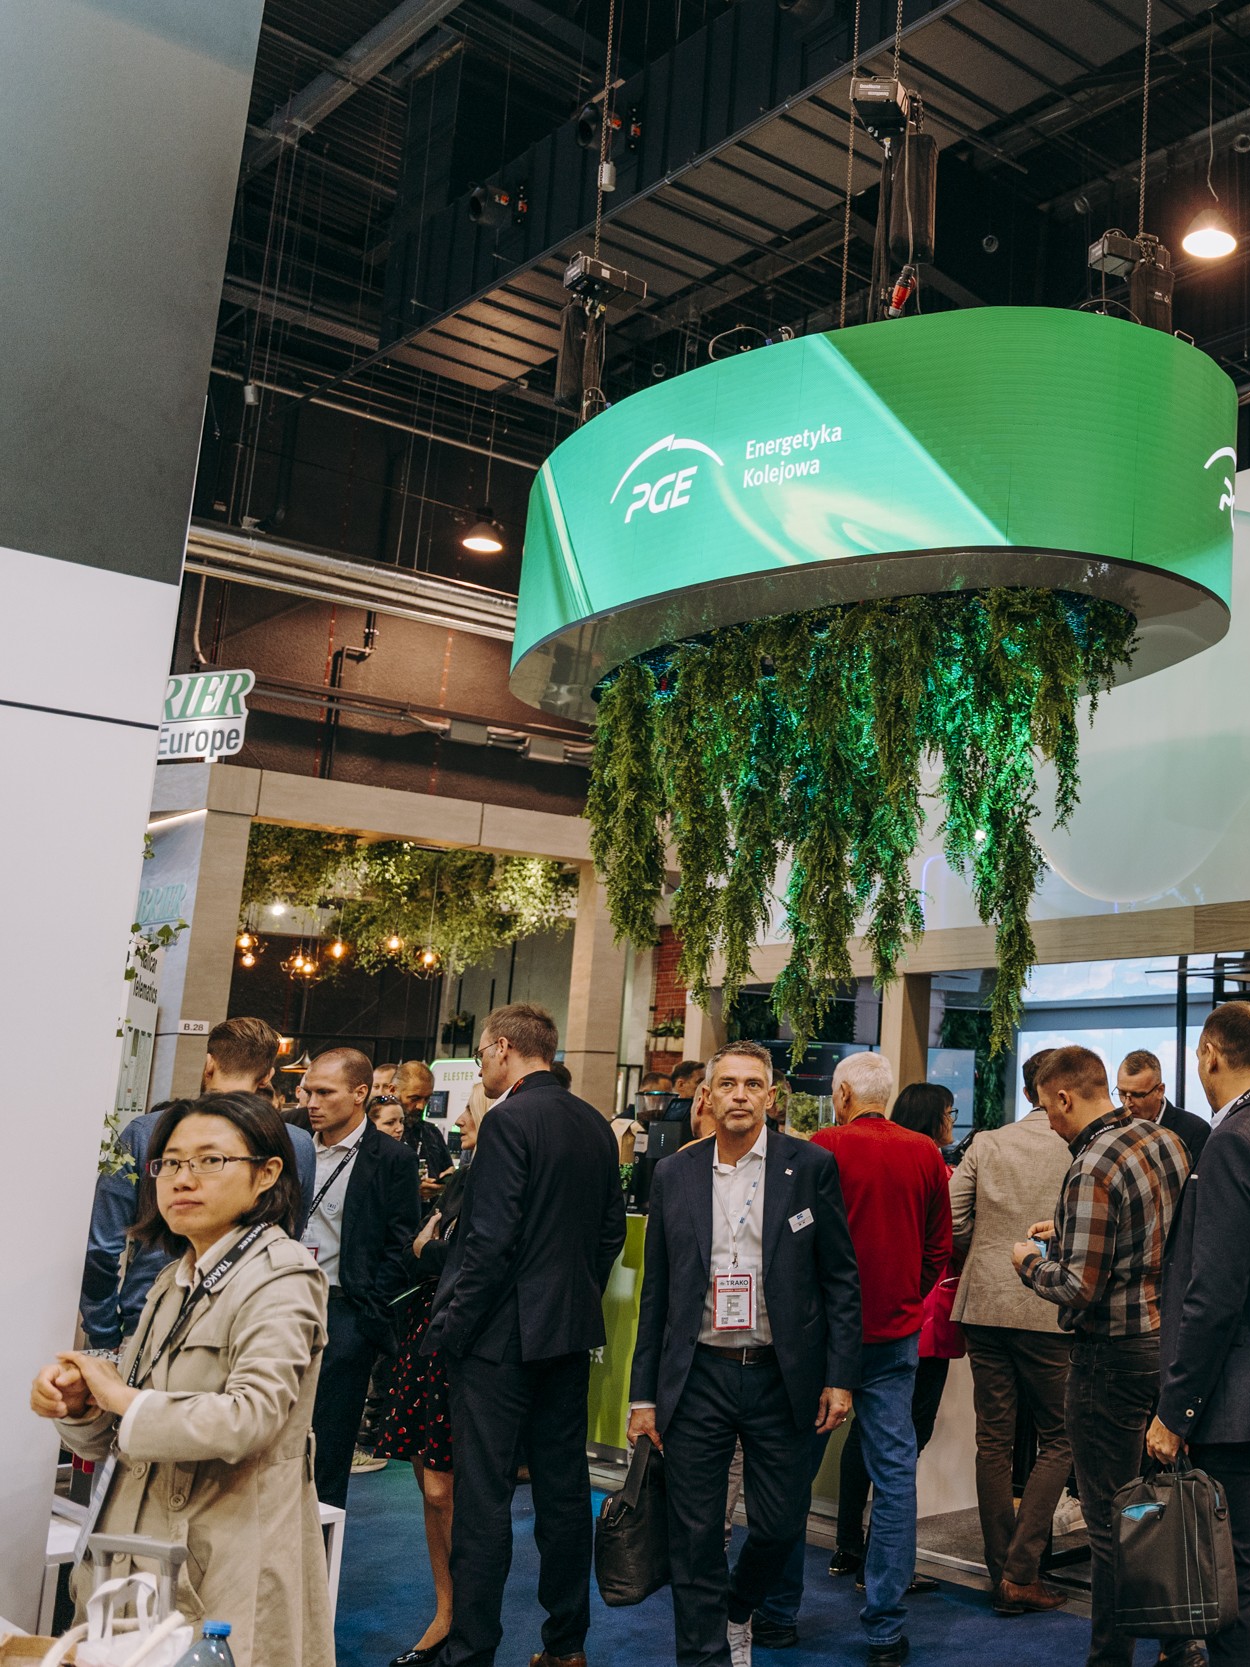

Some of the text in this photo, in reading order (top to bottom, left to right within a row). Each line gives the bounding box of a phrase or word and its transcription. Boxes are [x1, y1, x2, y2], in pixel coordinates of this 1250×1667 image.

[745, 424, 842, 460] Energetyka
[743, 458, 820, 489] Kolejowa
[624, 465, 698, 524] PGE
[164, 673, 251, 721] RIER
[158, 727, 240, 758] Europe
[183, 1023, 204, 1032] B.28
[443, 1071, 475, 1081] ELESTER
[342, 1147, 357, 1163] TRAKO
[202, 1257, 233, 1289] TRAKO
